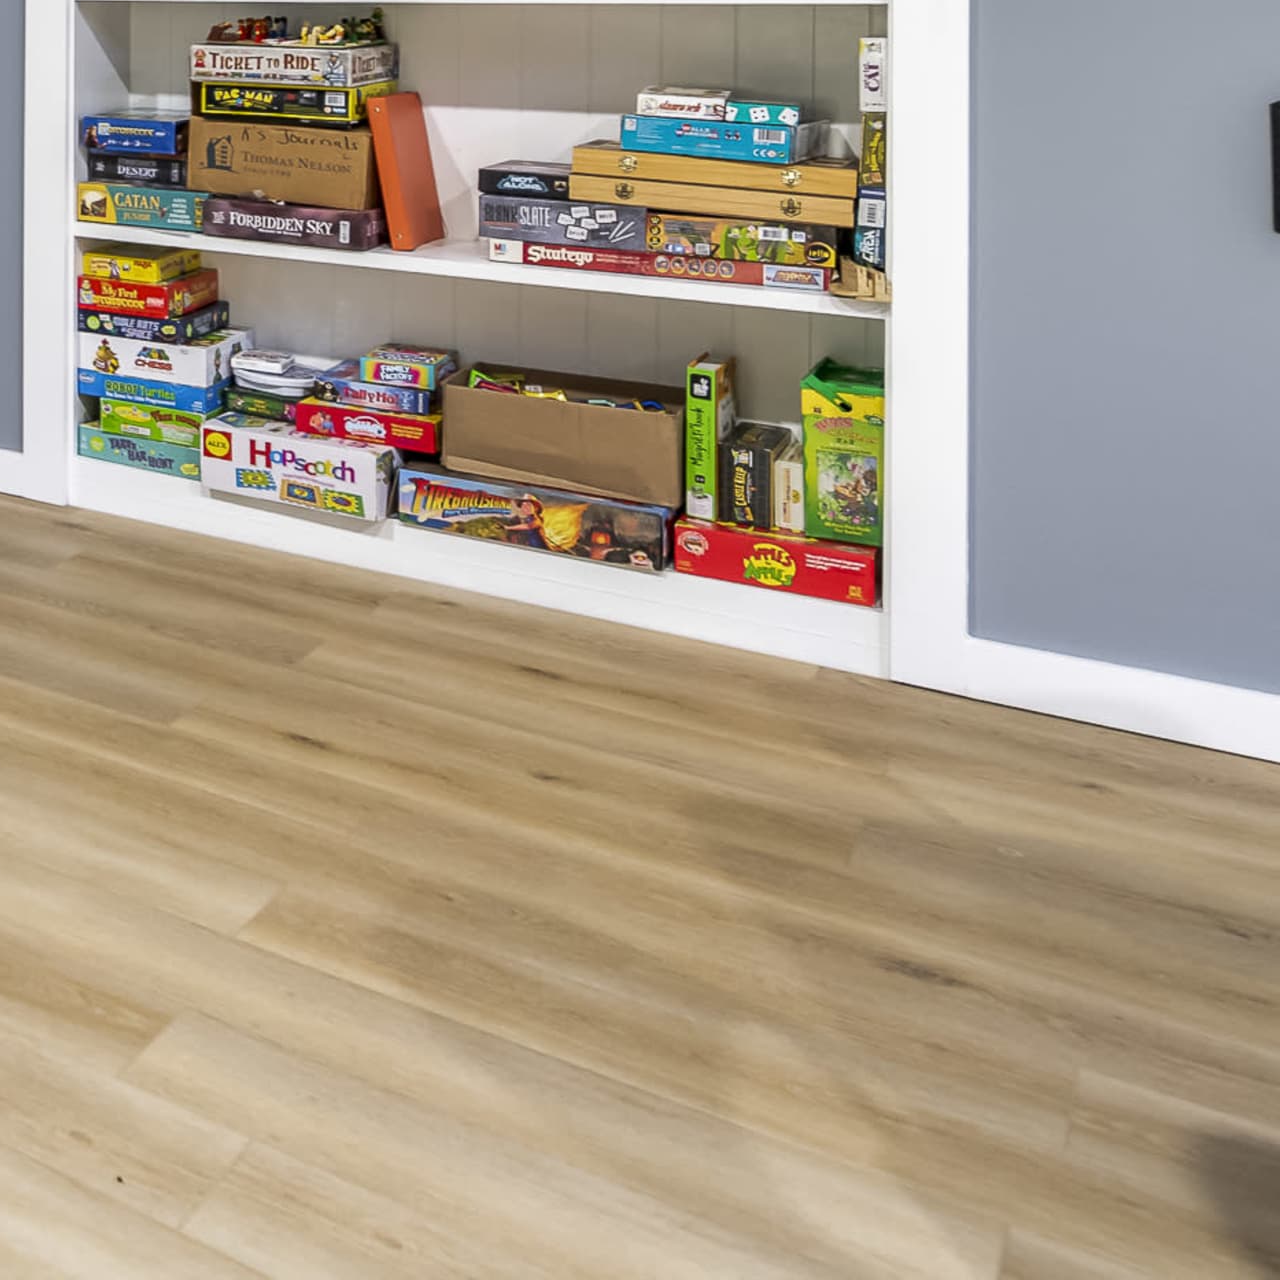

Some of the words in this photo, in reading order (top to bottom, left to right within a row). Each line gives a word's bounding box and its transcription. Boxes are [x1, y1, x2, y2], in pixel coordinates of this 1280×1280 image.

[208, 51, 265, 71] TICKET
[283, 53, 322, 72] RIDE
[214, 88, 274, 105] PAC-MAN
[117, 164, 160, 179] DESERT
[241, 151, 295, 168] THOMAS
[298, 158, 352, 174] NELSON
[114, 192, 161, 210] CATAN
[229, 211, 305, 234] FORBIDDEN
[306, 220, 335, 237] SKY
[519, 205, 552, 228] SLATE
[526, 245, 595, 267] Stratego
